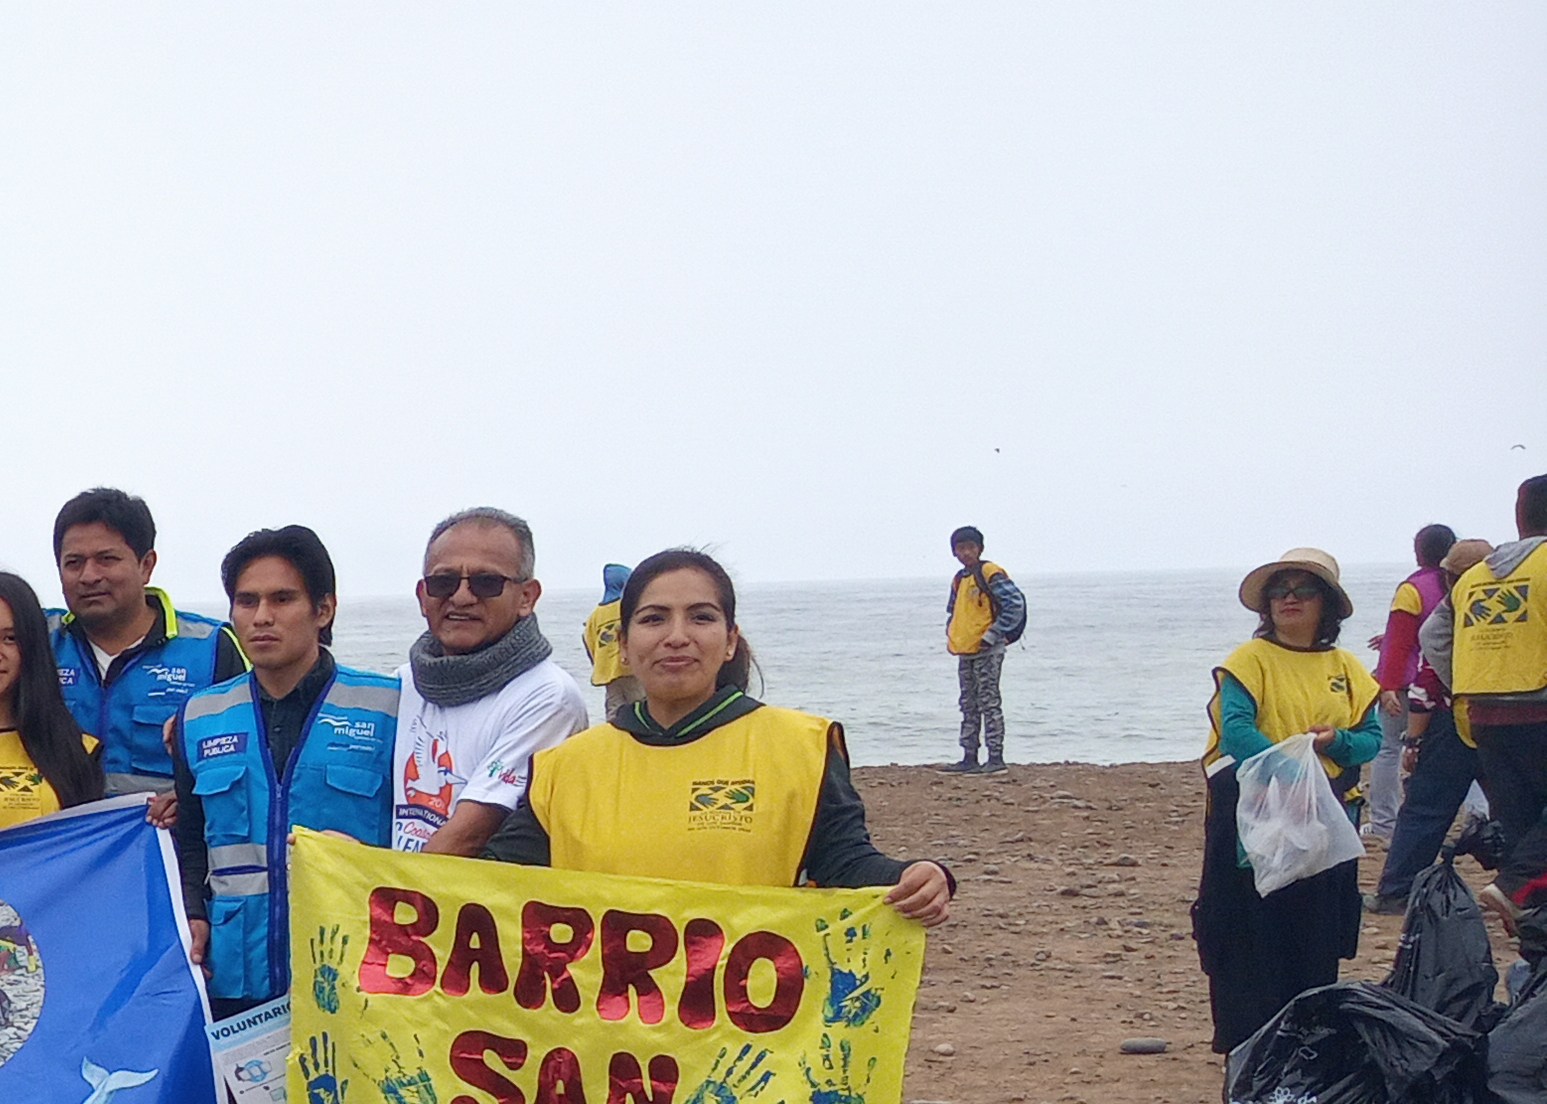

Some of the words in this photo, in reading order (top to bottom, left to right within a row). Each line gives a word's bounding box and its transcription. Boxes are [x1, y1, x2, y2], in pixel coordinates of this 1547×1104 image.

[334, 726, 375, 738] miguel
[202, 735, 238, 748] LIMPIEZA
[358, 886, 805, 1034] BARRIO
